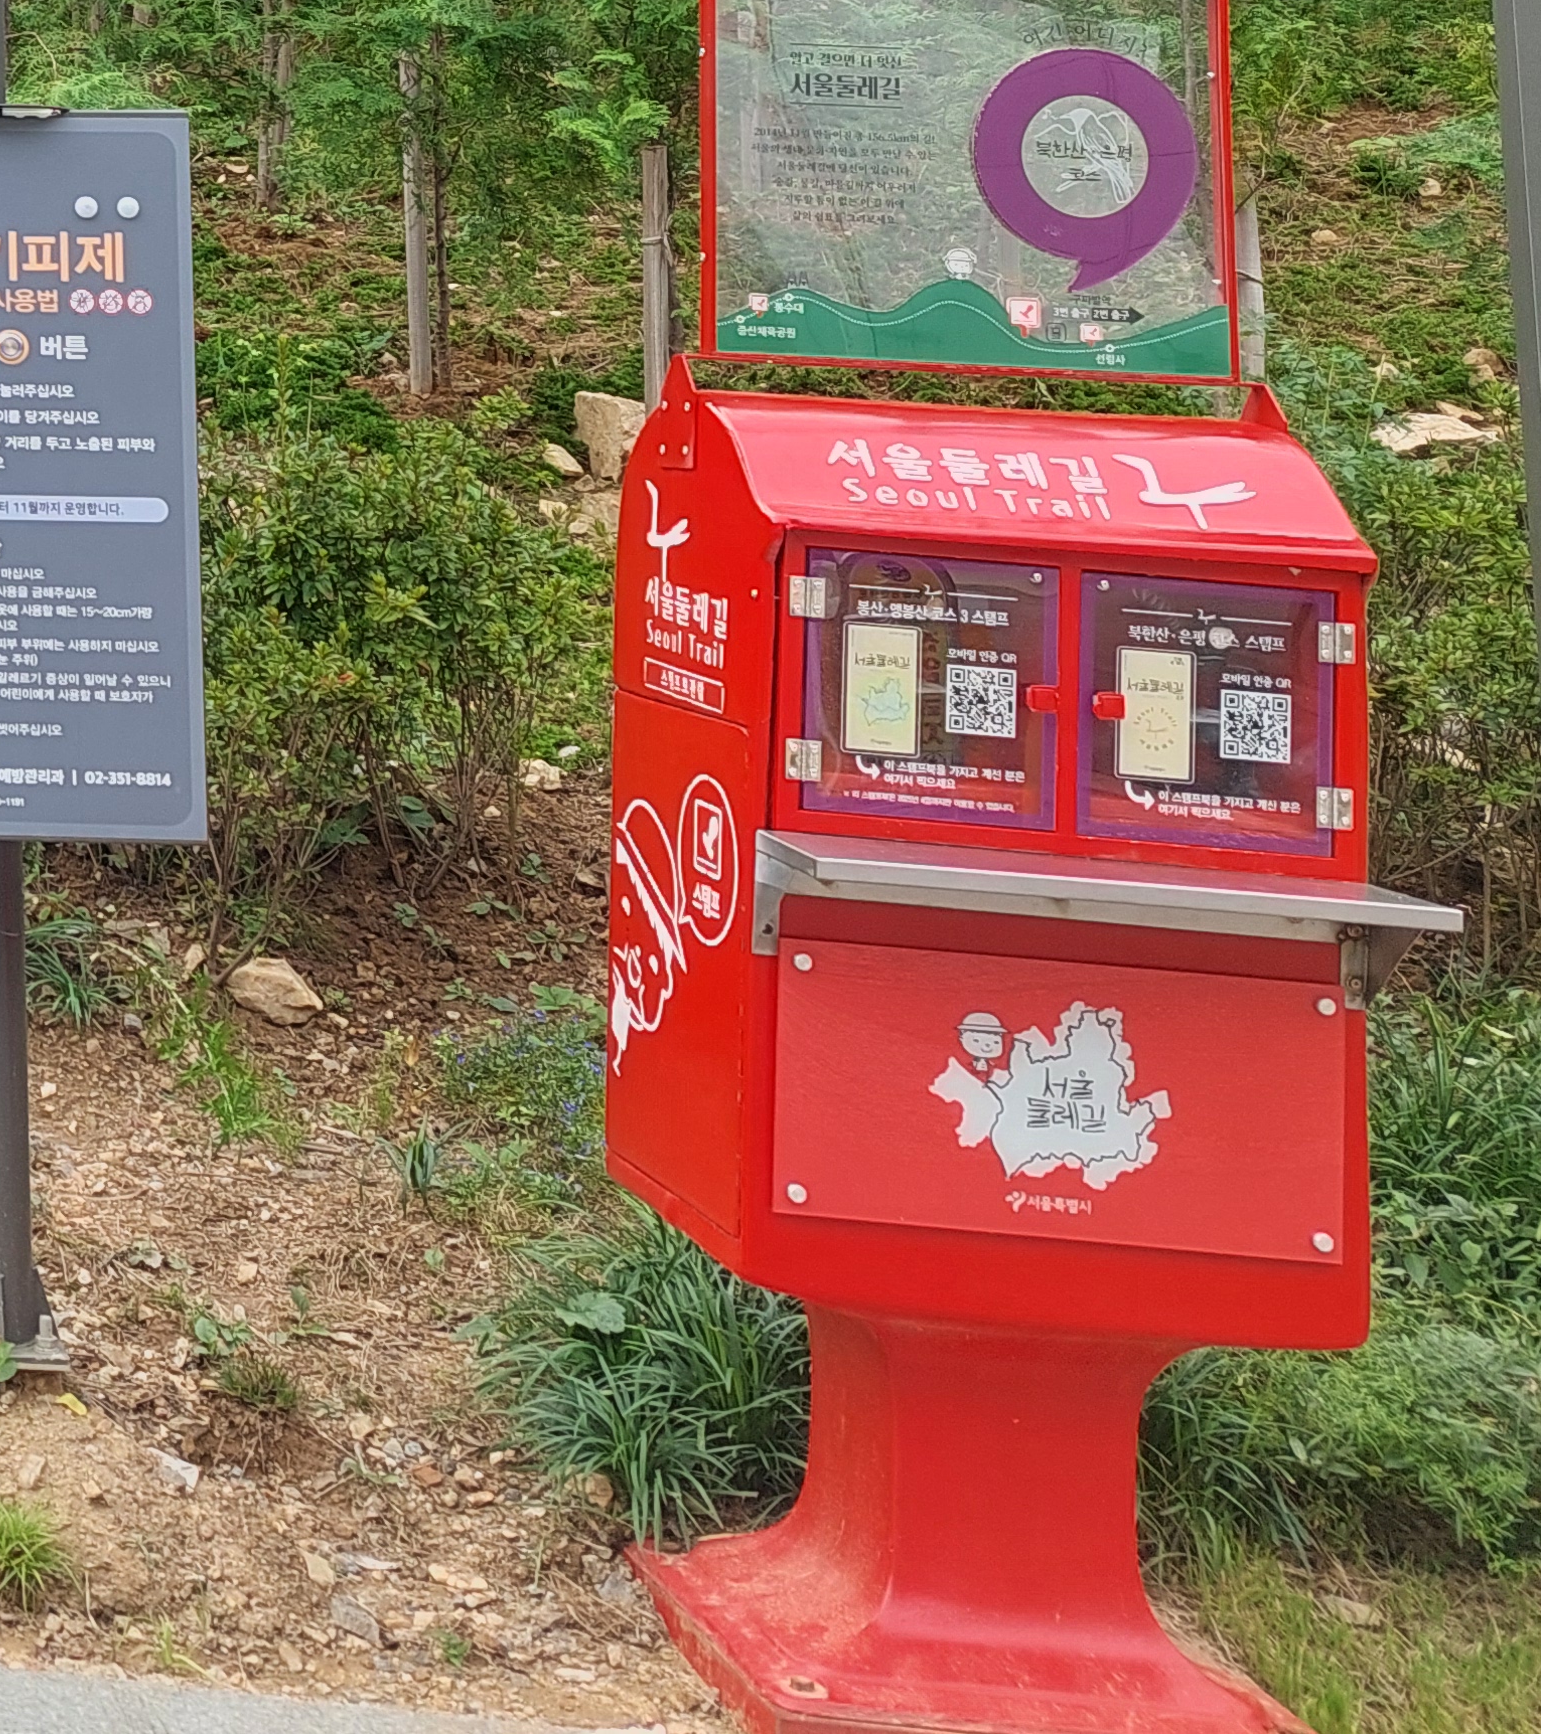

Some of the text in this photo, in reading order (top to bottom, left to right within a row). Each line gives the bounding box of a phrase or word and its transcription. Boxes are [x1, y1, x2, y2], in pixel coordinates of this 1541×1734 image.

[790, 51, 814, 65] 알고
[819, 52, 855, 67] 걸으면
[860, 54, 872, 67] 더
[790, 73, 901, 100] 서울둘레길
[1053, 307, 1068, 318] 3번
[1093, 309, 1108, 320] 2번
[737, 325, 796, 339] 증산체육공원
[40, 335, 89, 360] 버튼
[1095, 354, 1126, 366] 선림사
[0, 383, 75, 399] 눌러주십시오
[25, 409, 100, 425] 당겨주십시오
[5, 435, 42, 450] 거리를
[46, 437, 72, 450] 두고
[75, 437, 113, 451] 노출된
[117, 438, 155, 453] 피부와
[828, 438, 1107, 494] 서울둘레길
[842, 477, 1111, 520] Seoul Trail
[13, 501, 61, 515] 11월까지
[1, 567, 45, 580] 마십시오
[31, 586, 98, 600] 금해주십시오
[21, 604, 53, 617] 사용할
[56, 605, 78, 618] 때는
[644, 576, 728, 640] 서울둘레길
[930, 606, 958, 622] 코스
[961, 609, 968, 623] 3
[971, 610, 1009, 626] 스탬프
[21, 638, 65, 652] 부위에는
[68, 639, 112, 653] 사용하지
[115, 640, 160, 654] 마십시오
[646, 619, 724, 670] Seoul Trail
[1128, 624, 1206, 647] 북한산·은평
[1245, 636, 1286, 652] 스탬프
[947, 648, 1017, 665] 모바일 인증 QR
[83, 673, 117, 687] 일어날
[121, 674, 133, 687] 수
[137, 674, 171, 688] 있으니
[1219, 673, 1292, 690] 모바일 인증 QR
[0, 687, 54, 701] 어린이에게
[57, 689, 91, 702] 사용할
[94, 690, 106, 703] 때
[109, 690, 154, 703] 보호자가
[884, 760, 894, 772] 이
[949, 765, 979, 778] 가지고
[981, 767, 1002, 780] 계신
[884, 772, 914, 786] 여기서
[1158, 790, 1168, 802] 이
[1223, 796, 1253, 809] 가지고
[1257, 798, 1277, 812] 계신
[1158, 804, 1188, 817] 여기서
[692, 882, 721, 919] 스탬프
[1043, 1067, 1094, 1100] 서울
[1027, 1097, 1106, 1133] 둘레길
[1027, 1194, 1092, 1215] 서울특별시
